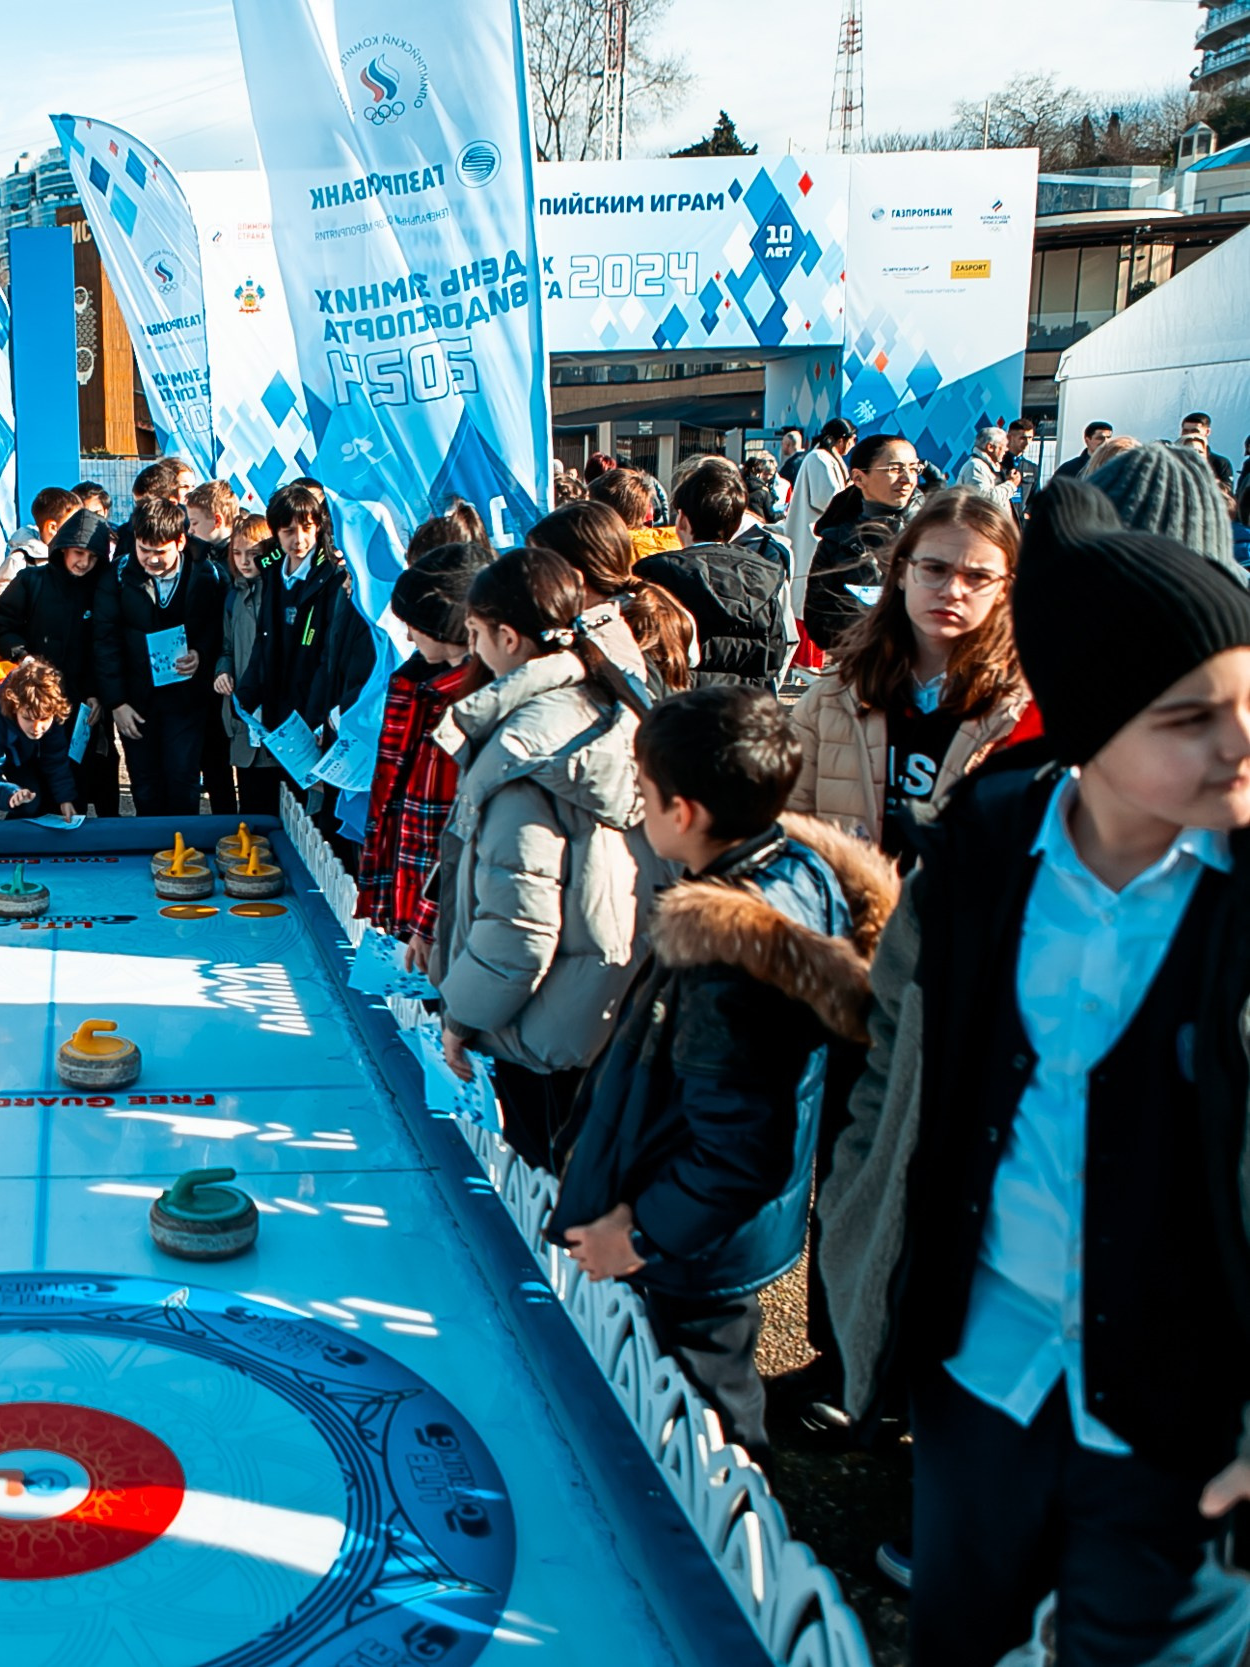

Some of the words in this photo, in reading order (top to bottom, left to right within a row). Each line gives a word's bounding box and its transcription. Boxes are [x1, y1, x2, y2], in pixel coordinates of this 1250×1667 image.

[540, 193, 643, 215] ПИЙСКИМ
[651, 192, 724, 213] ИГРАМ
[891, 208, 952, 218] ГАЗПРОМБАНК
[237, 232, 265, 240] СТРАНА
[766, 225, 793, 244] 10
[955, 264, 988, 272] ZASPORT
[569, 251, 699, 299] 2024
[128, 1093, 216, 1106] FREE
